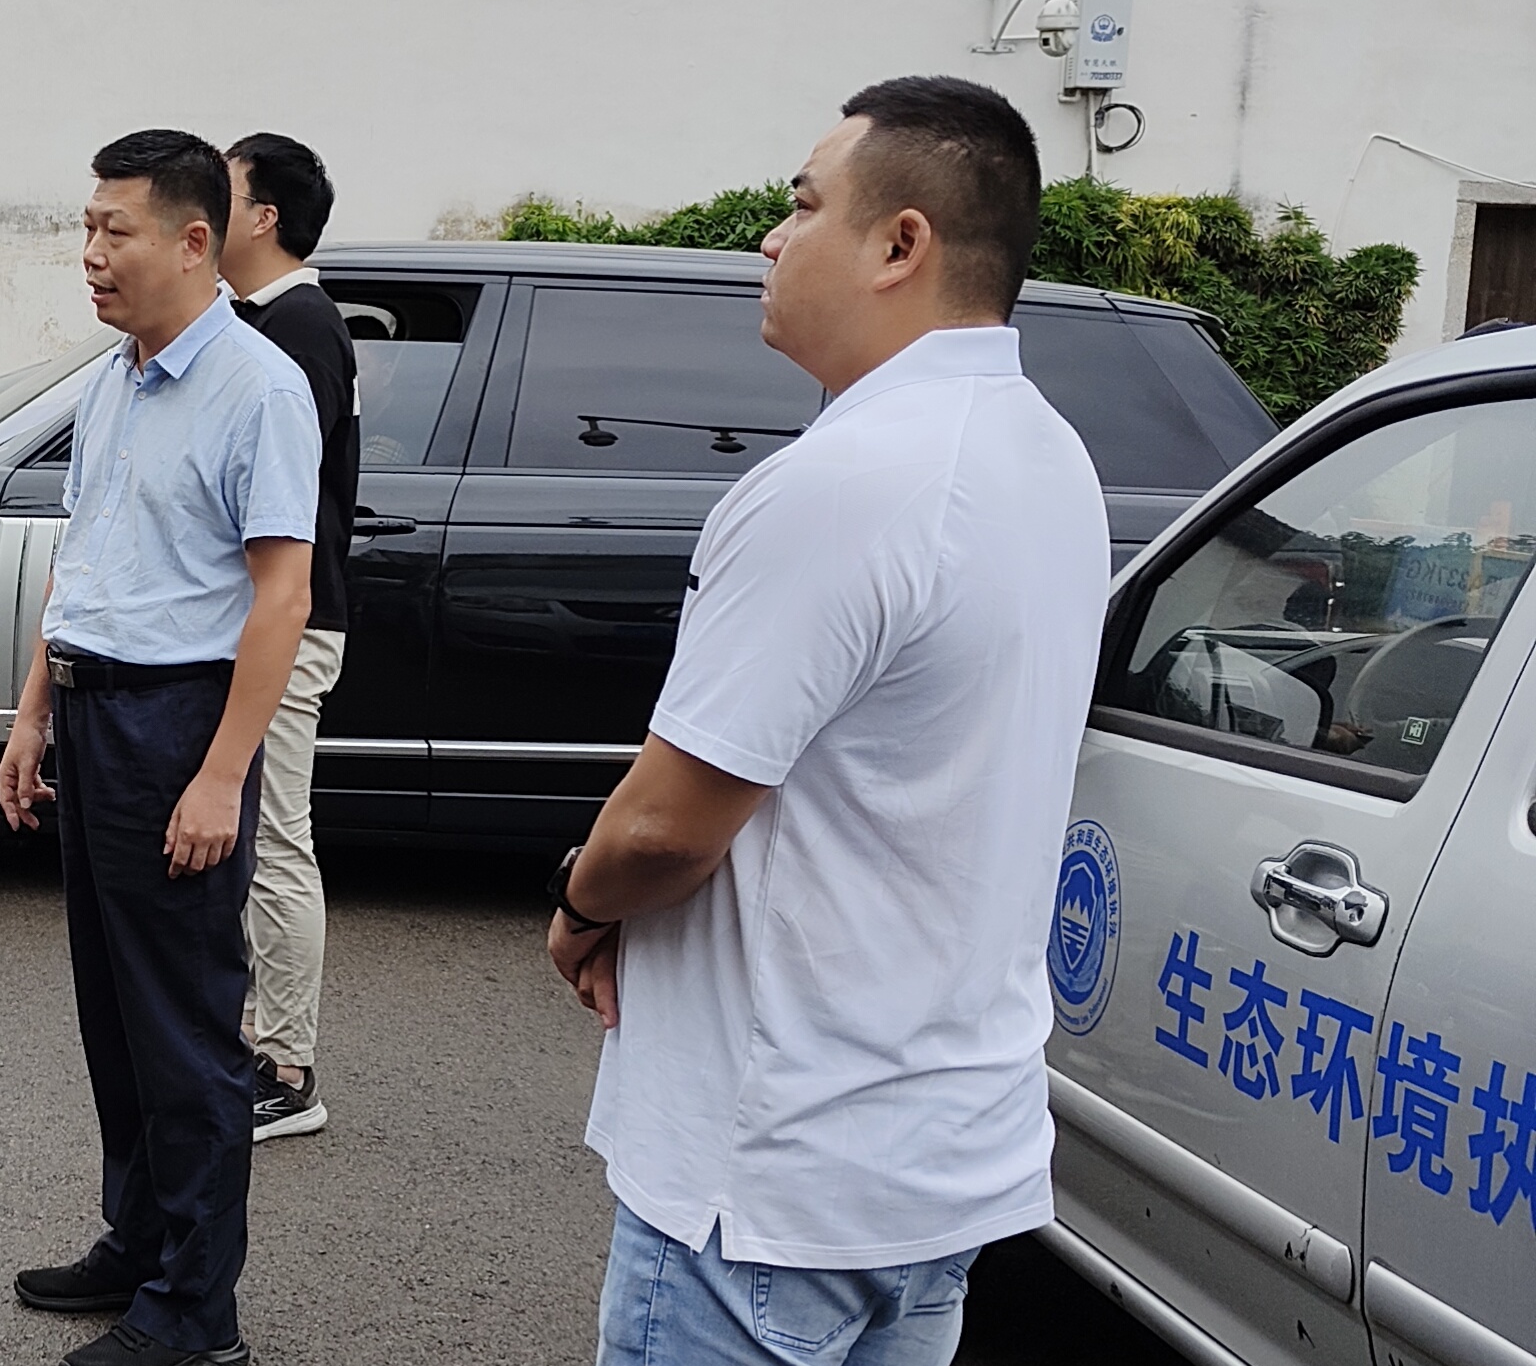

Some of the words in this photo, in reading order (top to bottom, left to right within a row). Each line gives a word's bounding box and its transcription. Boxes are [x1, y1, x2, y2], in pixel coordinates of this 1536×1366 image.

[1155, 930, 1536, 1235] 生态环境执
